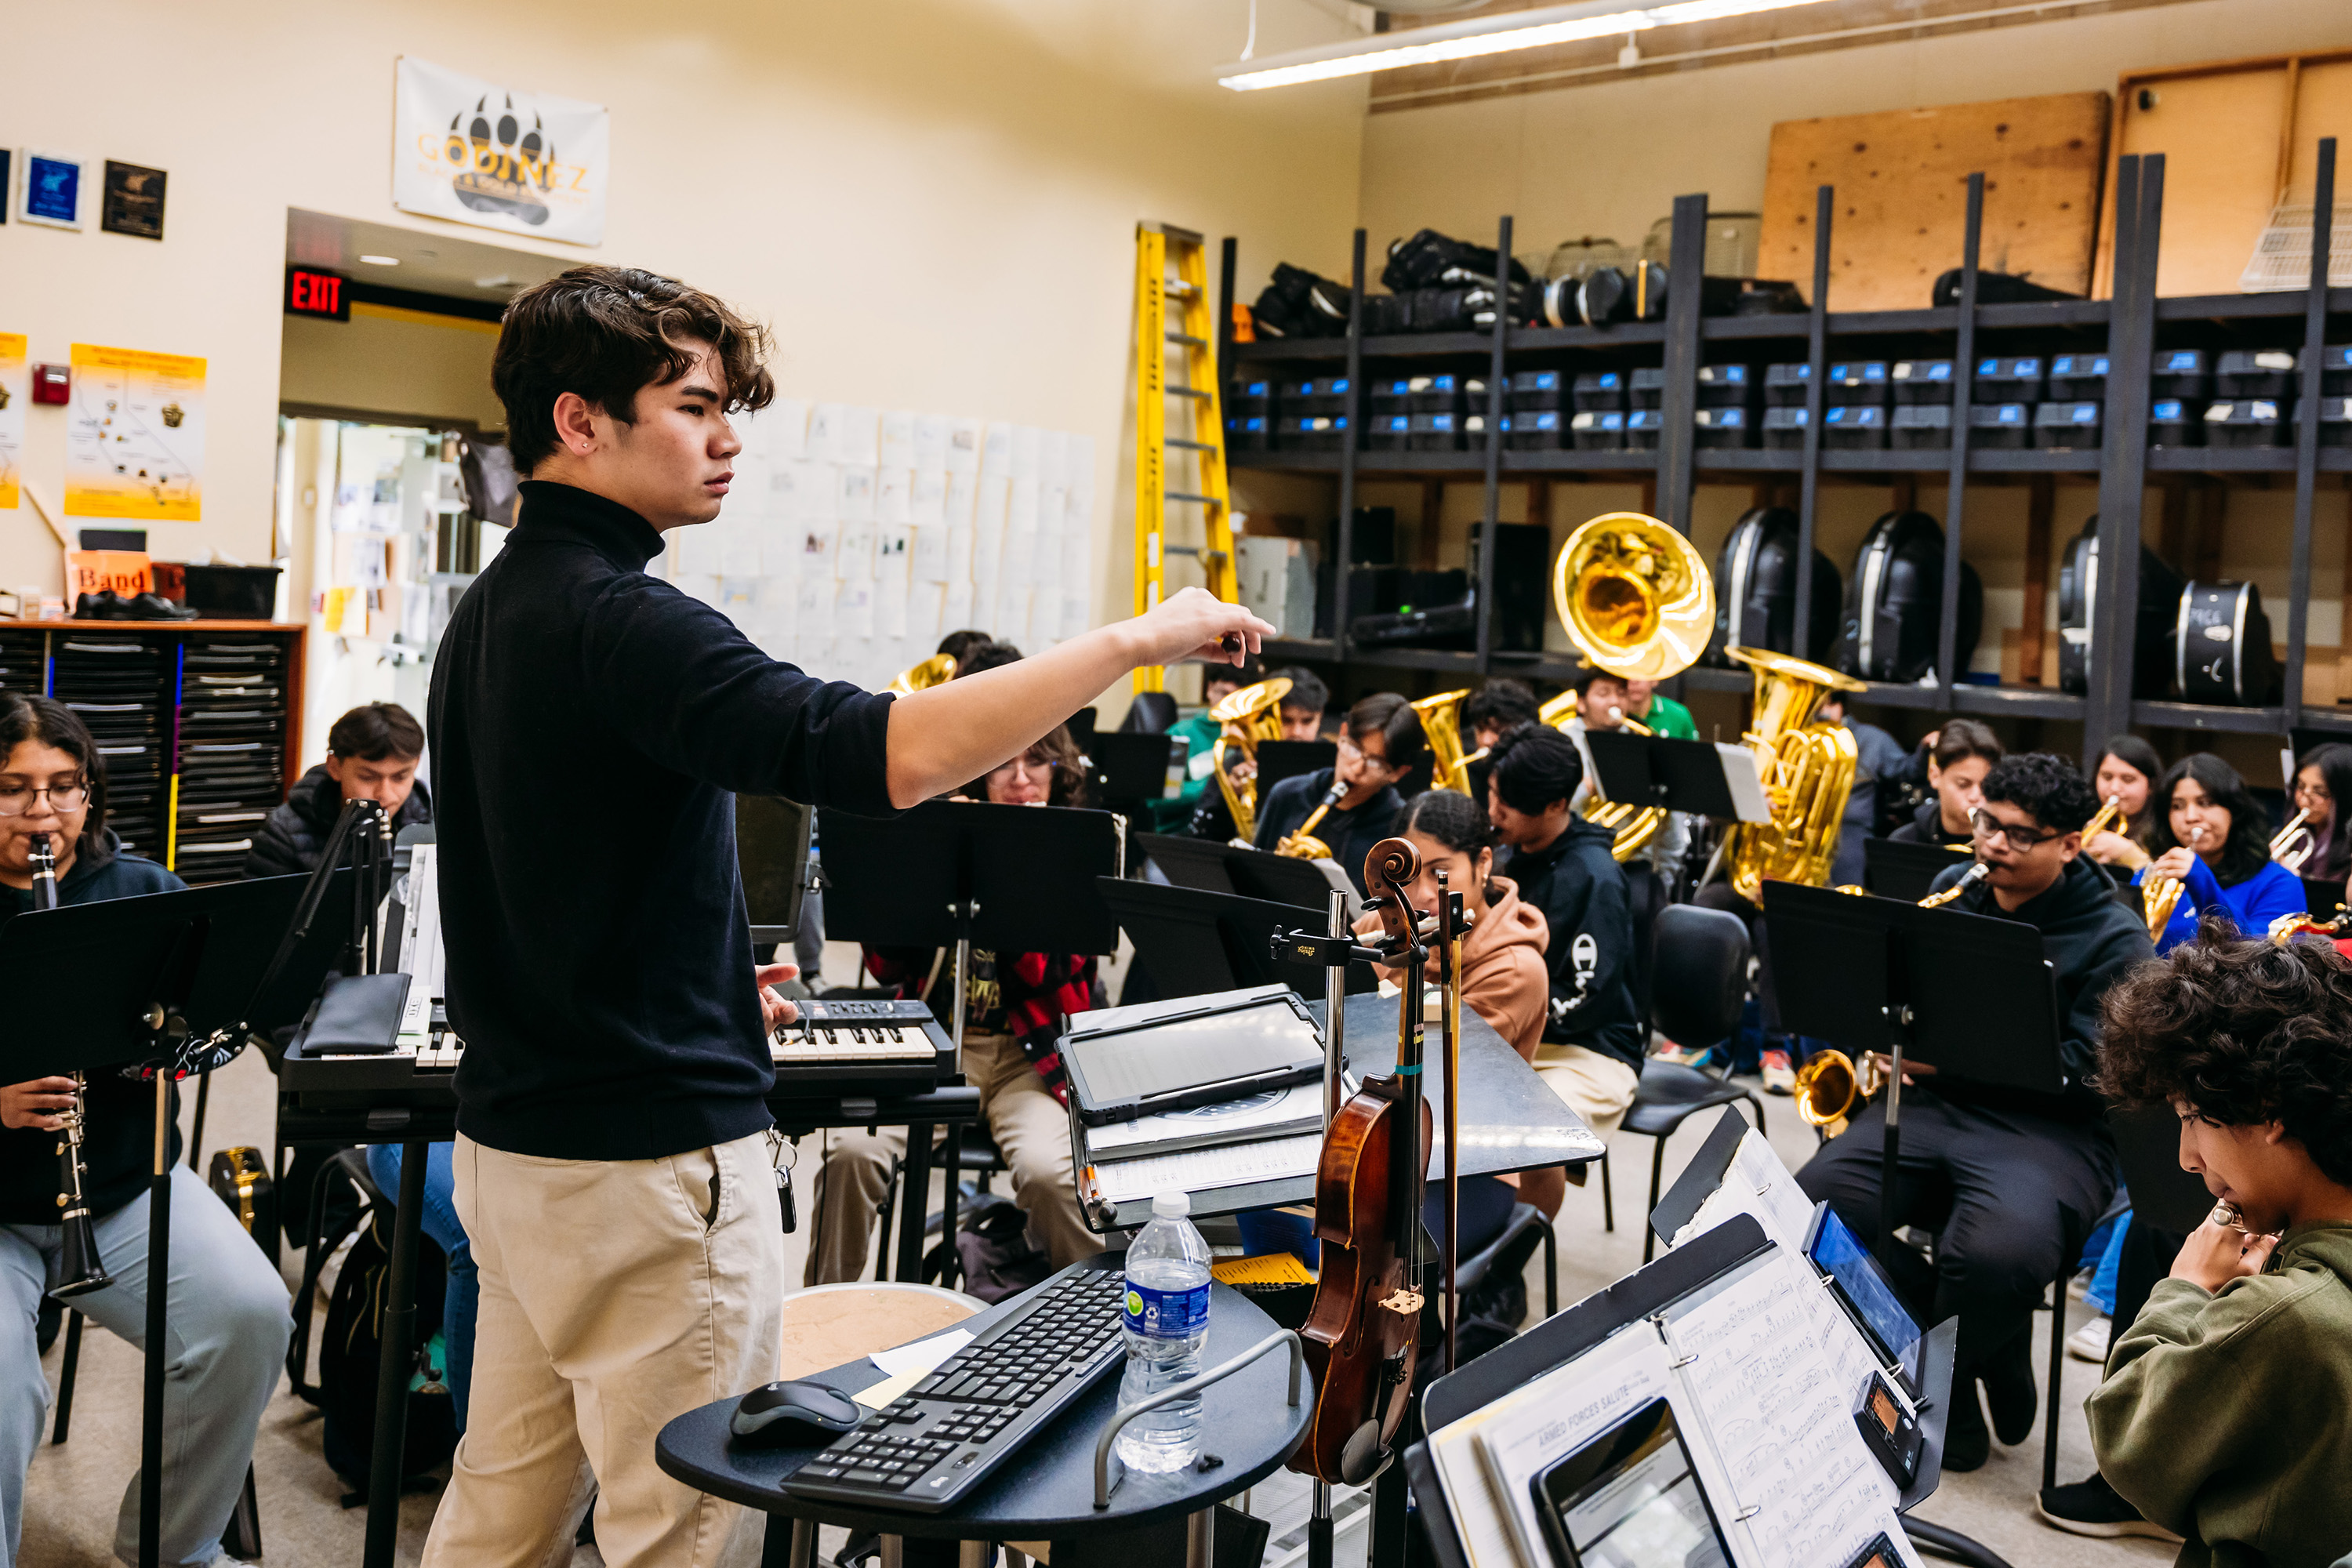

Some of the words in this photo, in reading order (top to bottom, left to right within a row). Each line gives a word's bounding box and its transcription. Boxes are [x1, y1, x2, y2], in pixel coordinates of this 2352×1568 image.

[418, 133, 590, 193] GODINEZ
[292, 271, 342, 314] EXIT
[79, 566, 145, 588] Band
[1546, 933, 1598, 1025] Champ
[1539, 1421, 1567, 1448] ARMED
[1567, 1402, 1600, 1430] FORCES
[1601, 1384, 1630, 1410] SALUTE
